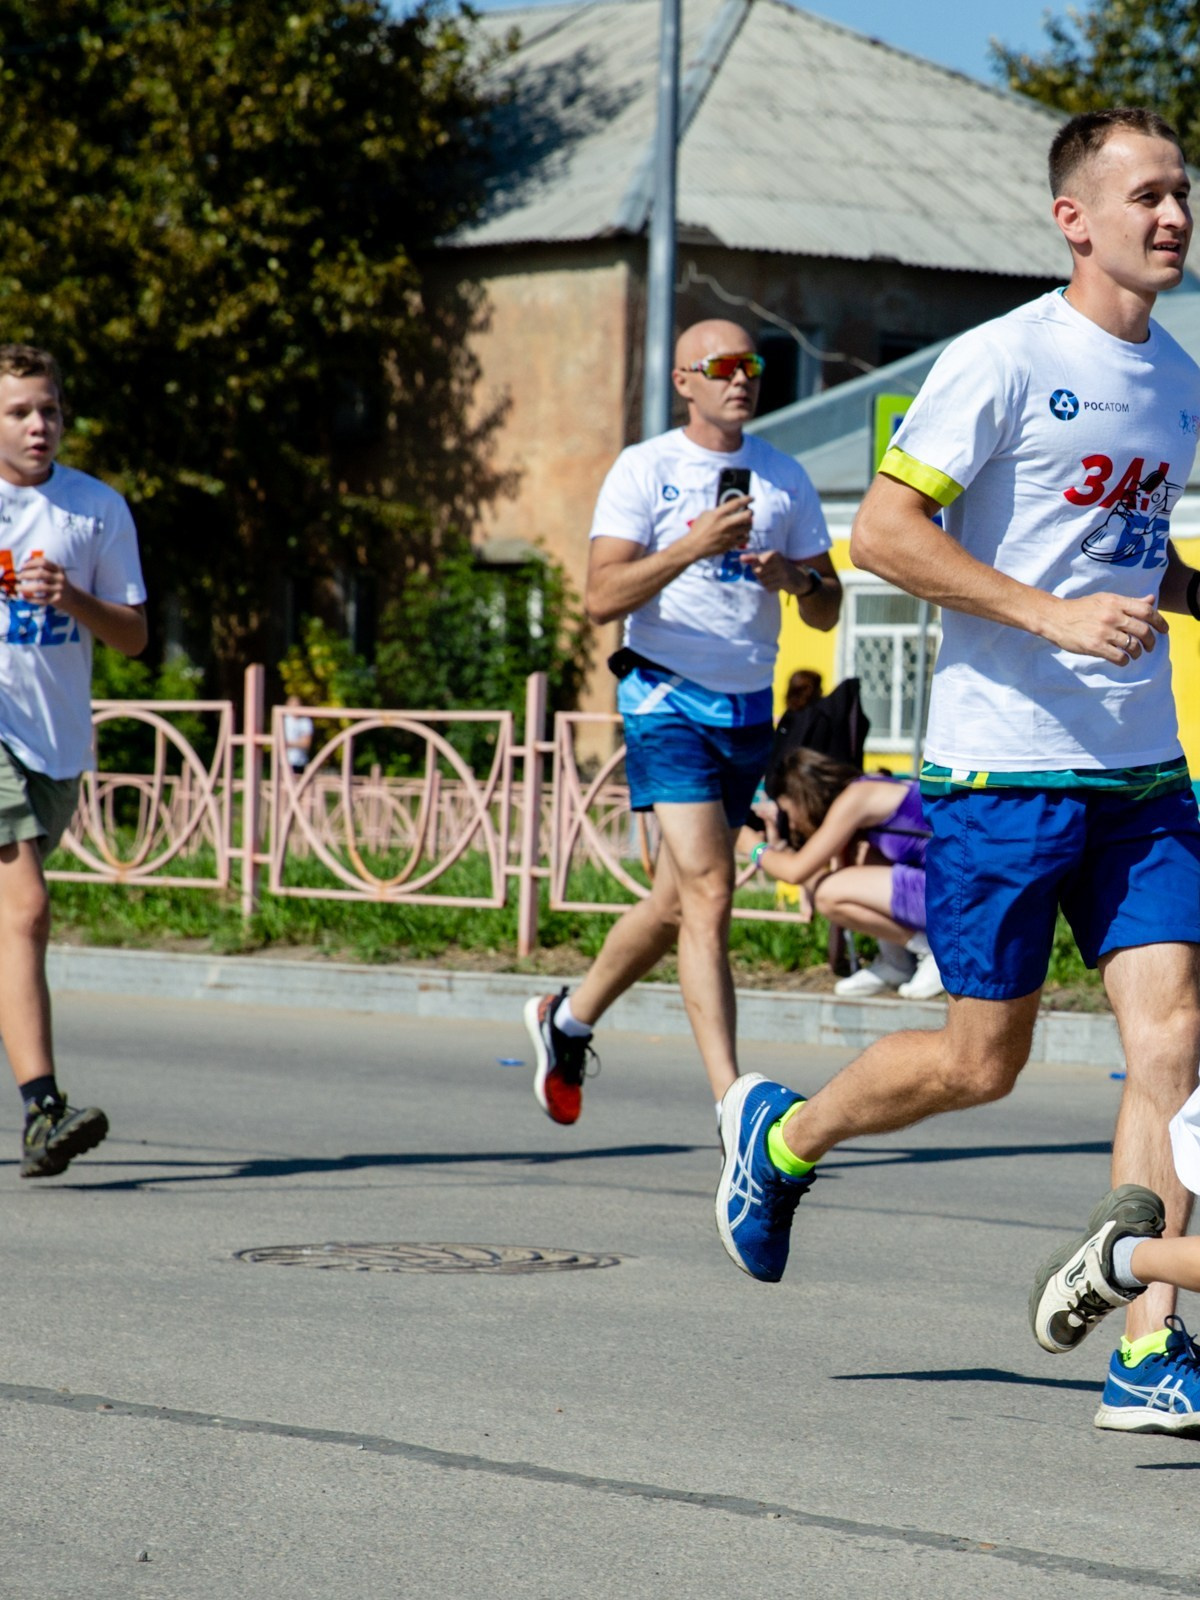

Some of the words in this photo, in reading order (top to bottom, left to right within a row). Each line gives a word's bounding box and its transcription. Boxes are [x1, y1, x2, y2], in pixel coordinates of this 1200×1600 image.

[1083, 401, 1130, 413] РОСАТОМ
[1063, 454, 1170, 511] ЗА!
[1110, 514, 1170, 570] БЕ
[6, 599, 81, 646] БЕ
